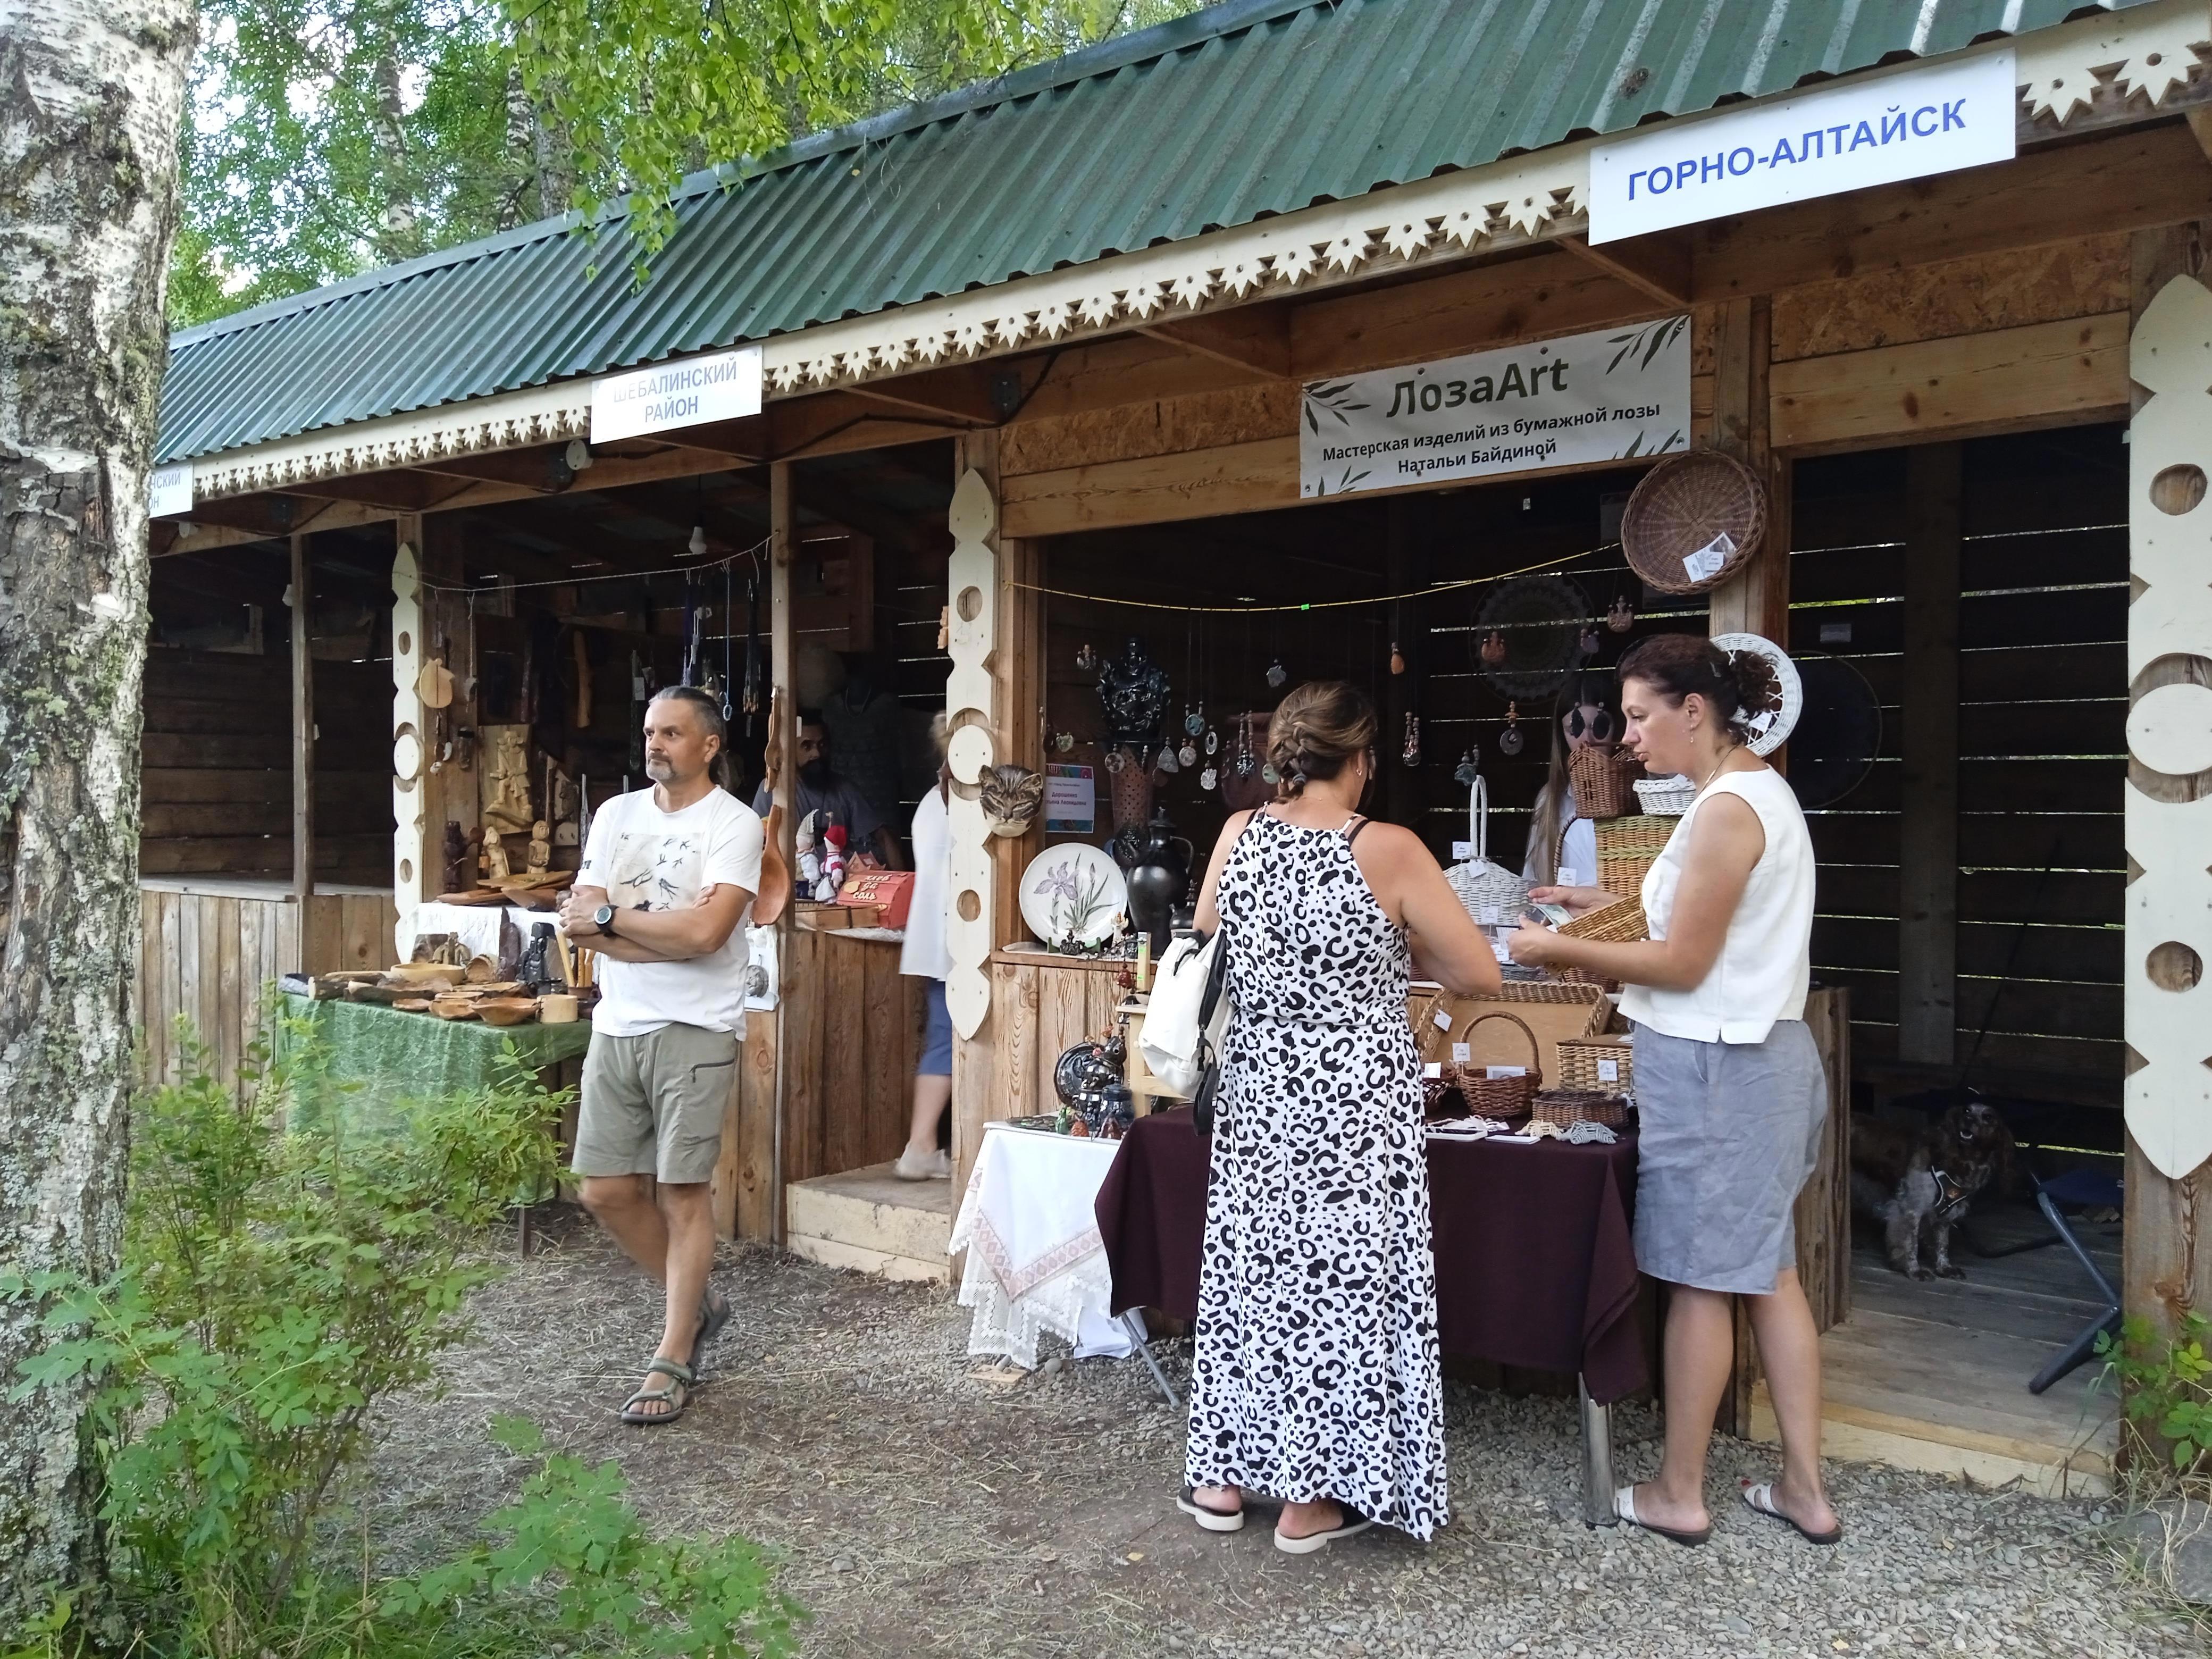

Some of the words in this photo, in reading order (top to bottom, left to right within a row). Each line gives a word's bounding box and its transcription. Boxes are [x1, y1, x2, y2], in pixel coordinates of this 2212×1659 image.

[1628, 98, 1967, 201] ГОРНО-АЛТАЙСК
[614, 356, 737, 403] ШЕБАЛИНСКИЙ
[1386, 358, 1569, 418] ЛозаArt
[644, 395, 699, 423] РАЙОН
[1323, 438, 1409, 461] Мастерская
[1413, 424, 1486, 448] изделий
[1489, 424, 1510, 438] из
[1513, 407, 1607, 436] бумажной
[1611, 404, 1660, 421] лозы
[1398, 454, 1465, 473] Натальи
[1471, 438, 1556, 464] Байдиной
[149, 469, 180, 489] НСКИЙ
[852, 892, 877, 900] соль
